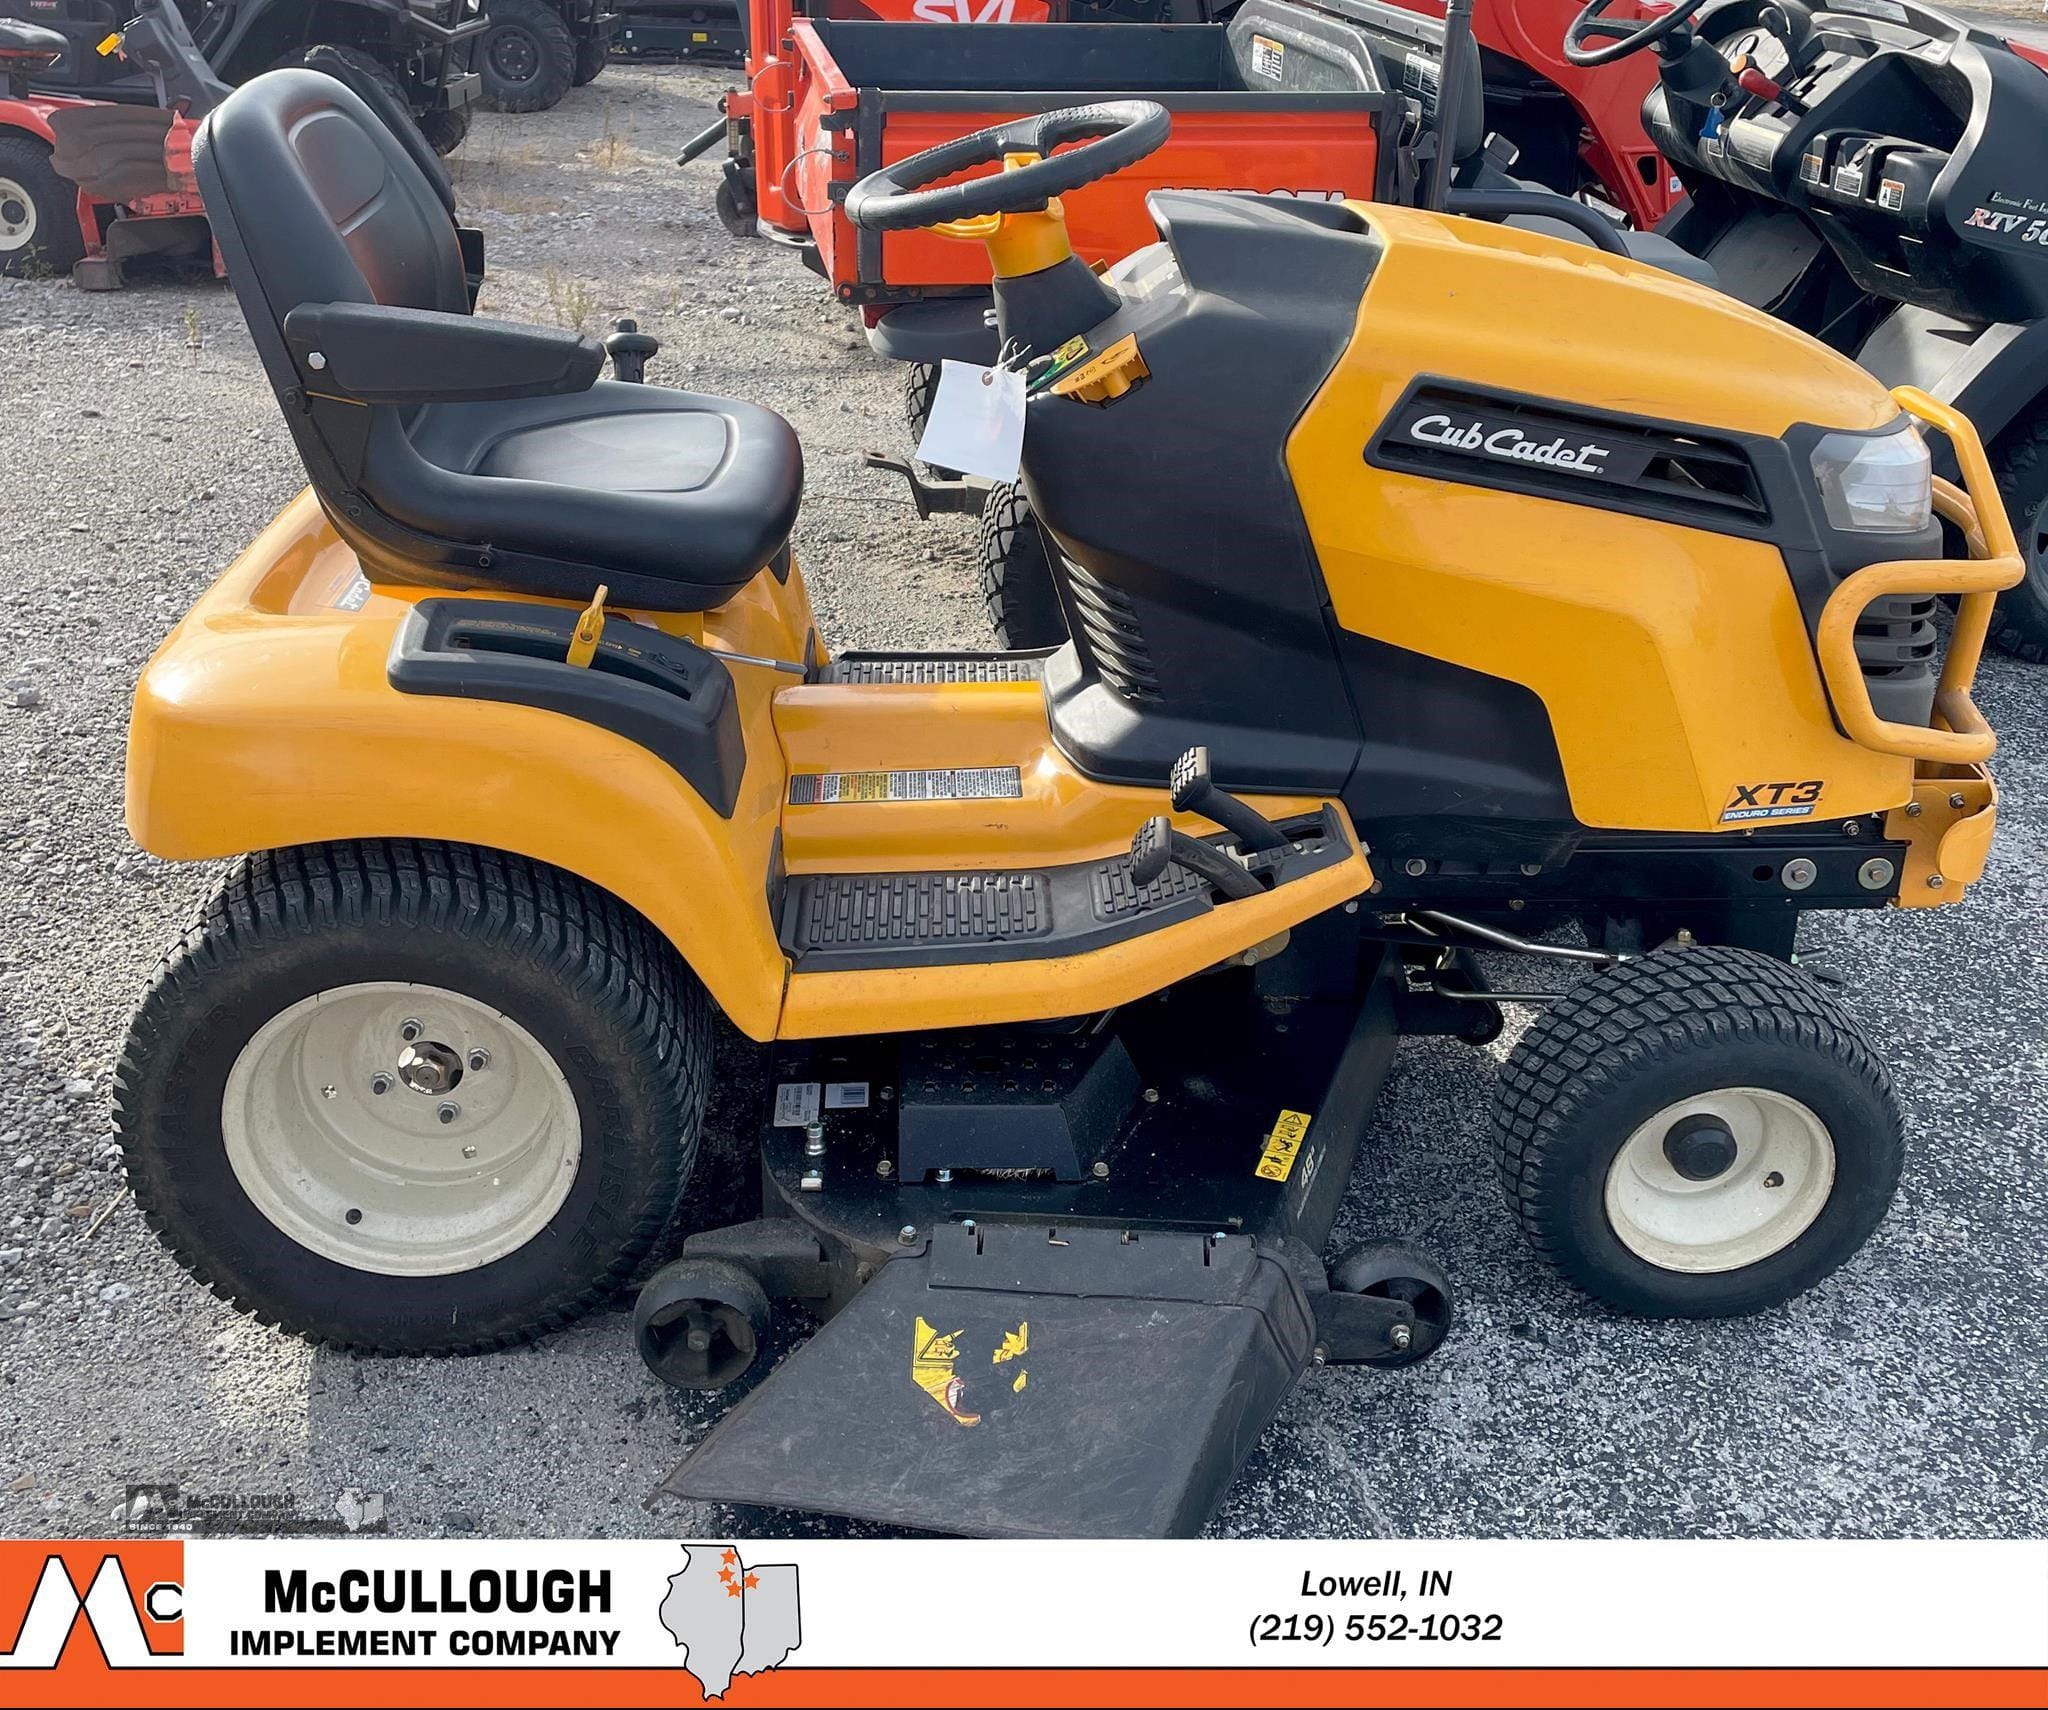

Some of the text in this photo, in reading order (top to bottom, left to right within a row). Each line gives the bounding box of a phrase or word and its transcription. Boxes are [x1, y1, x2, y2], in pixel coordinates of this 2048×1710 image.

[1964, 207, 2027, 233] RTV
[1410, 415, 1609, 473] Cub Cadet
[1727, 780, 1823, 808] XT3
[1724, 806, 1810, 820] ENDURO SERIES
